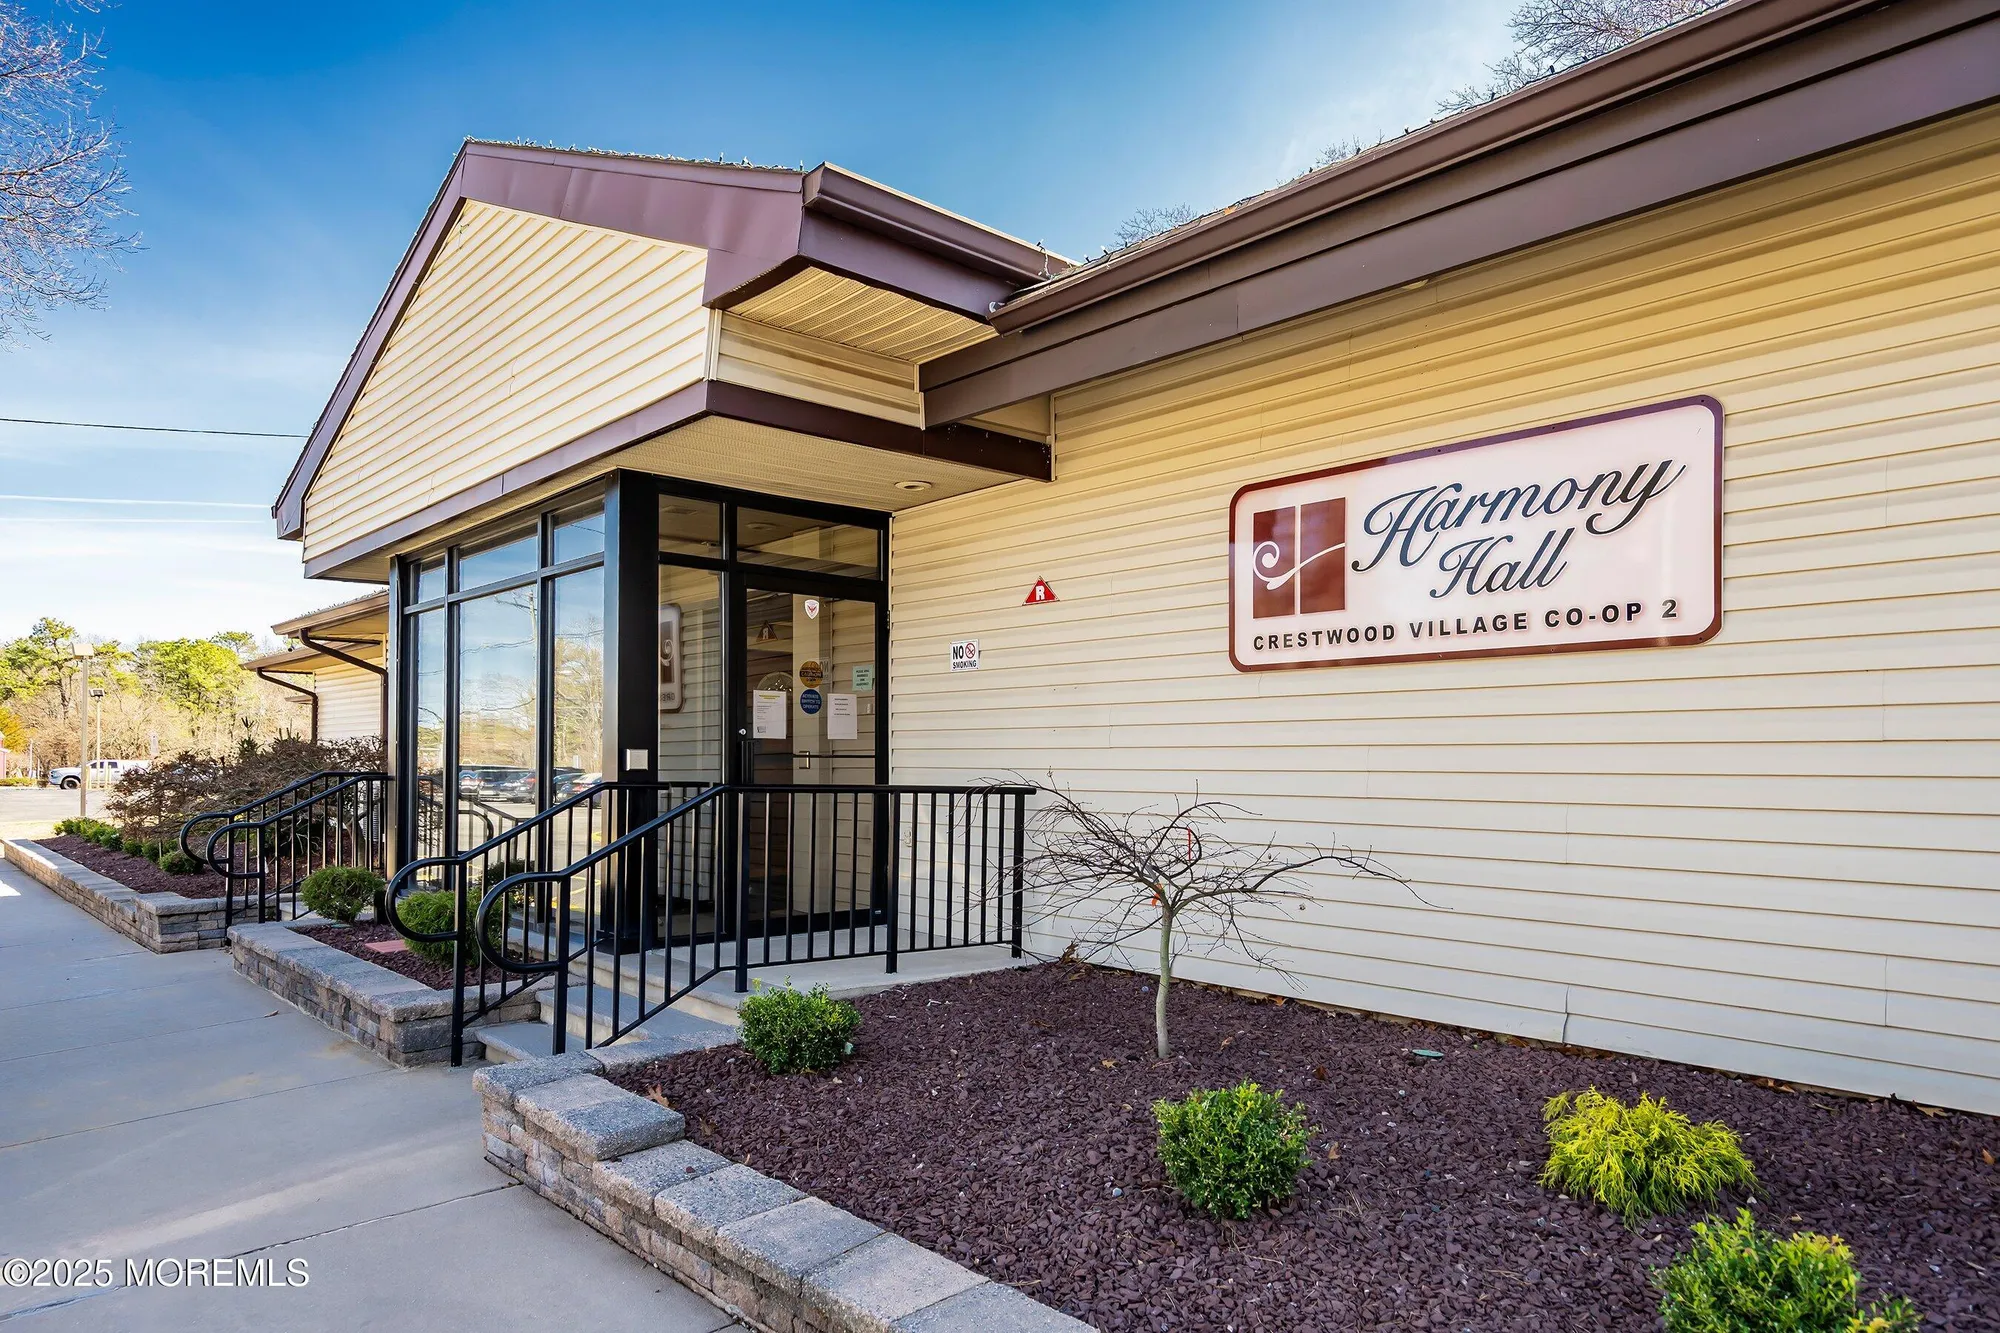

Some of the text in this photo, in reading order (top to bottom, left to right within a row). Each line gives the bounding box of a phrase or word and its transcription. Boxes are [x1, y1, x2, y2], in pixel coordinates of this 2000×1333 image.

[1352, 459, 1687, 572] Harmony
[1430, 528, 1574, 598] Hall
[1035, 585, 1045, 600] R
[1253, 599, 1677, 650] CRESTWOOD VILLAGE CO-OP 2
[952, 645, 964, 659] NO
[953, 660, 977, 669] SMOKING
